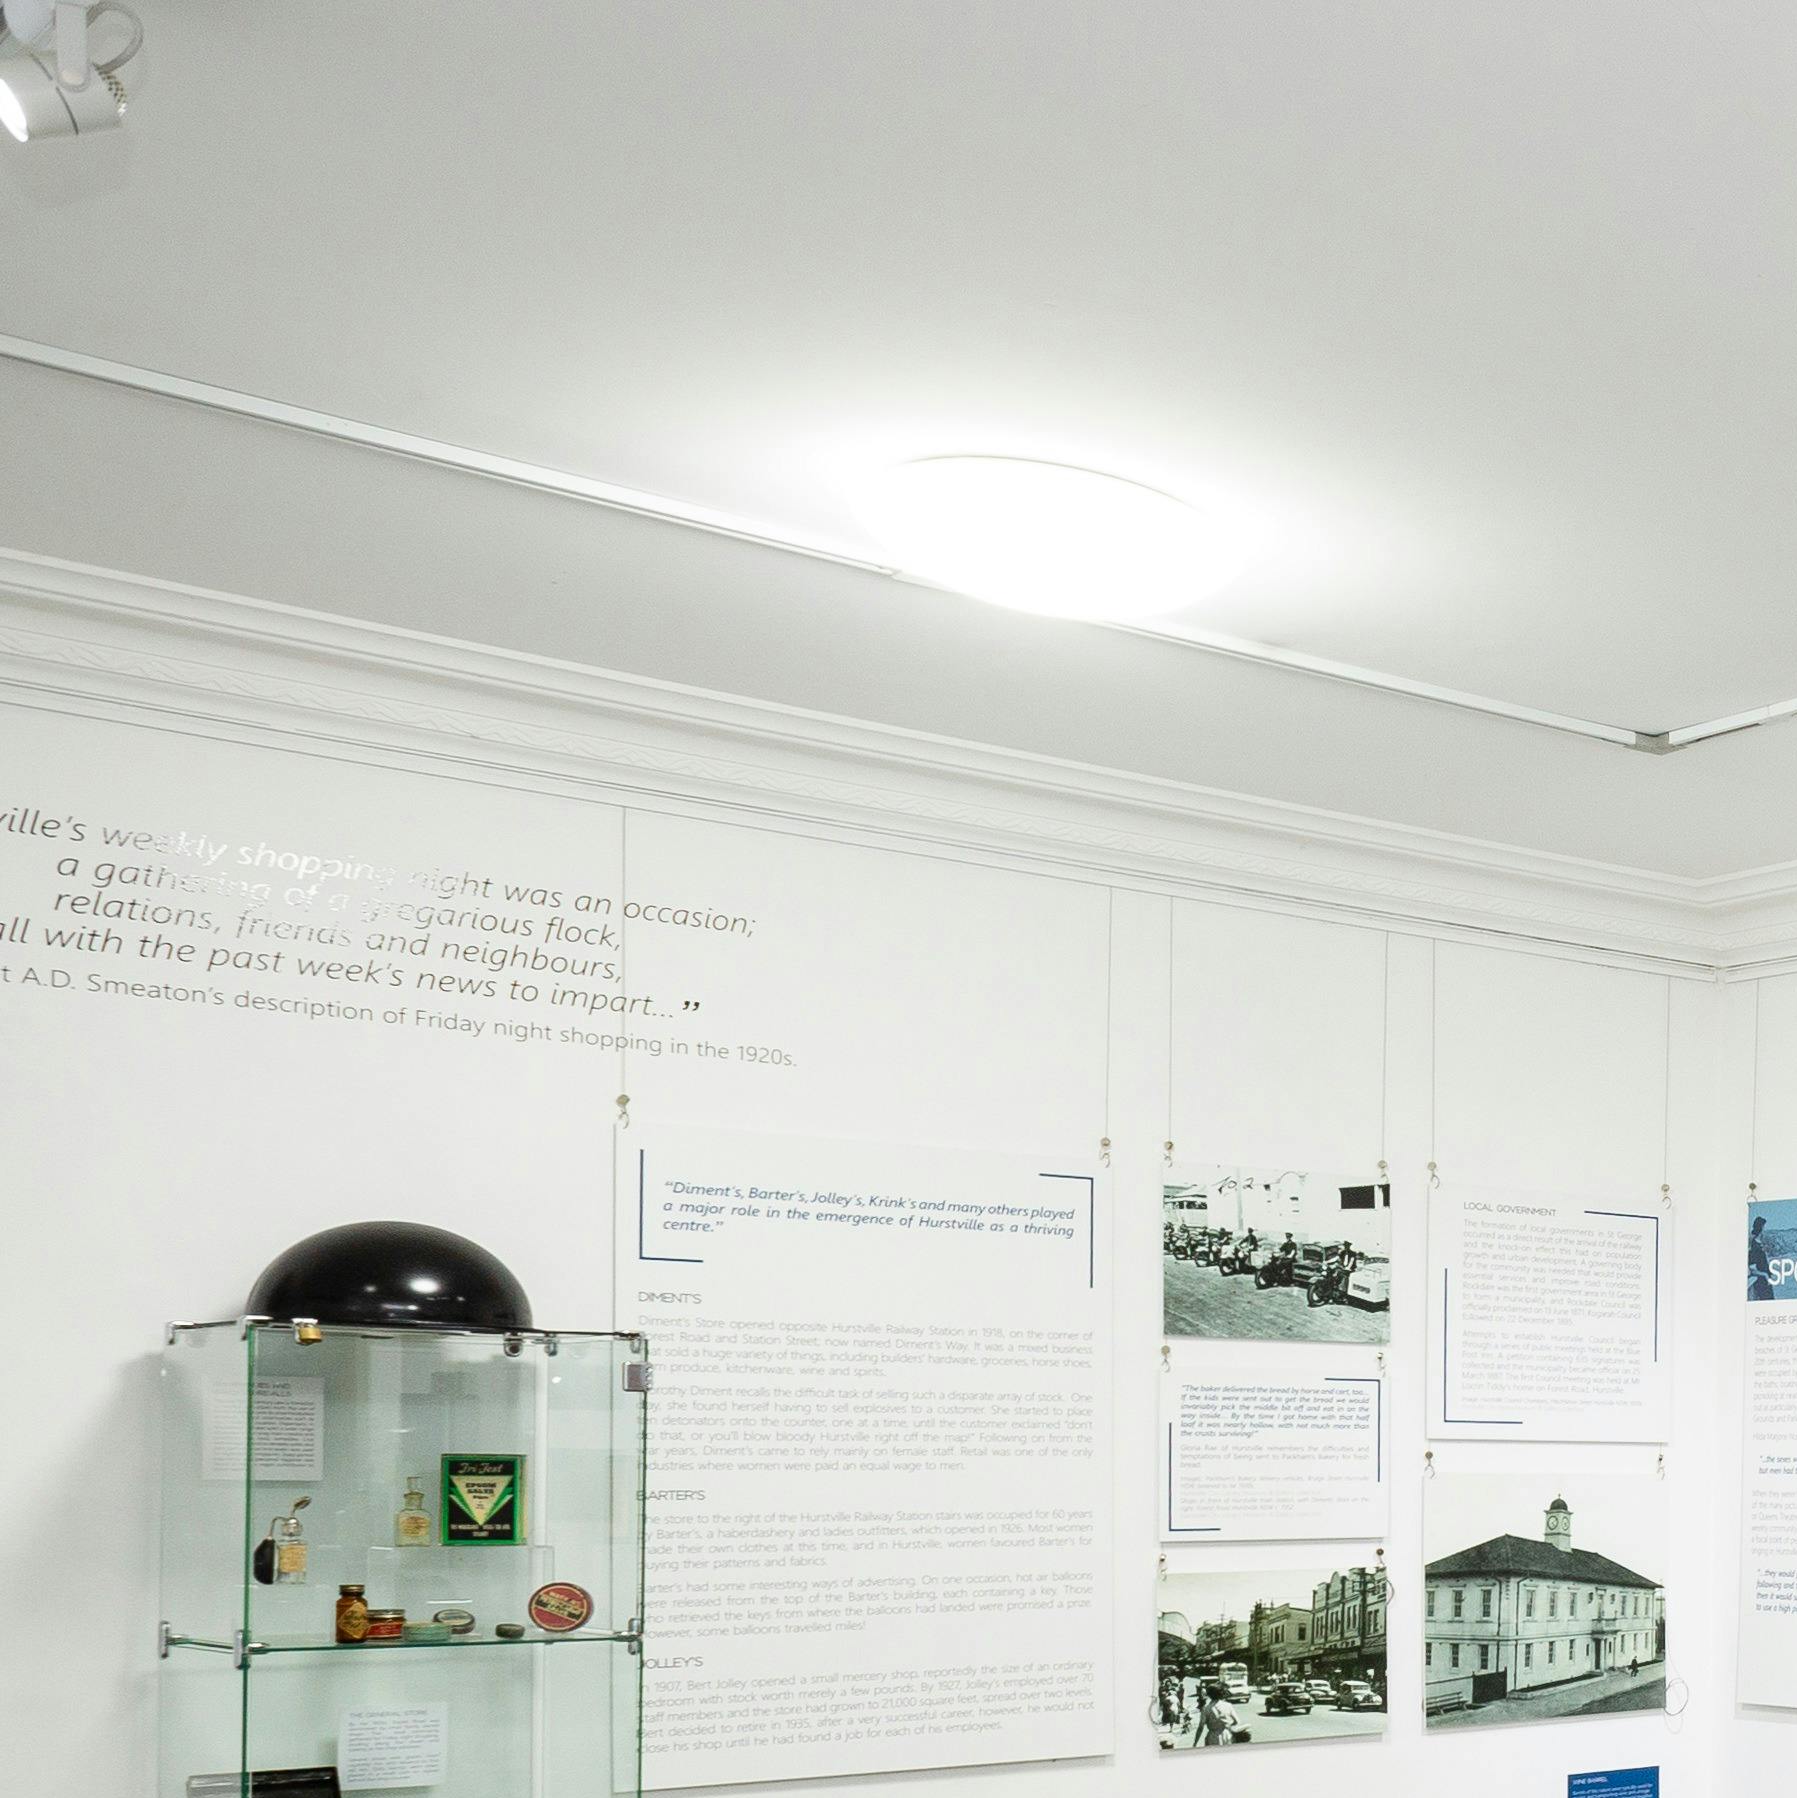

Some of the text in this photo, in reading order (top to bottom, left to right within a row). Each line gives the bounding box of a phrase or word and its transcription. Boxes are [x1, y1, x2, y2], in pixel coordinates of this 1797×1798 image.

[57, 857, 621, 951] a gathering of a gregarious flock,
[103, 828, 227, 862] weekly
[239, 842, 397, 888] shopping
[411, 868, 491, 899] night
[504, 884, 563, 908] was
[575, 895, 612, 915] an
[622, 895, 757, 938] occasion;
[45, 925, 123, 955] with
[139, 936, 197, 963] the
[206, 949, 287, 976] past
[298, 959, 404, 988] week's
[417, 973, 498, 998] news
[510, 980, 540, 1003] to
[54, 890, 622, 984] relations, friends and neighbours,
[21, 968, 796, 1066] A.D. Smeaton's description of Friday night shopping in the 1920s.
[664, 1181, 1076, 1223] “Diment's, Barter's, Jolley's, Krink's and many others played
[1464, 1202, 1556, 1216] LOCAL GOVERNMENT
[1755, 1315, 1787, 1326] PLEASURE
